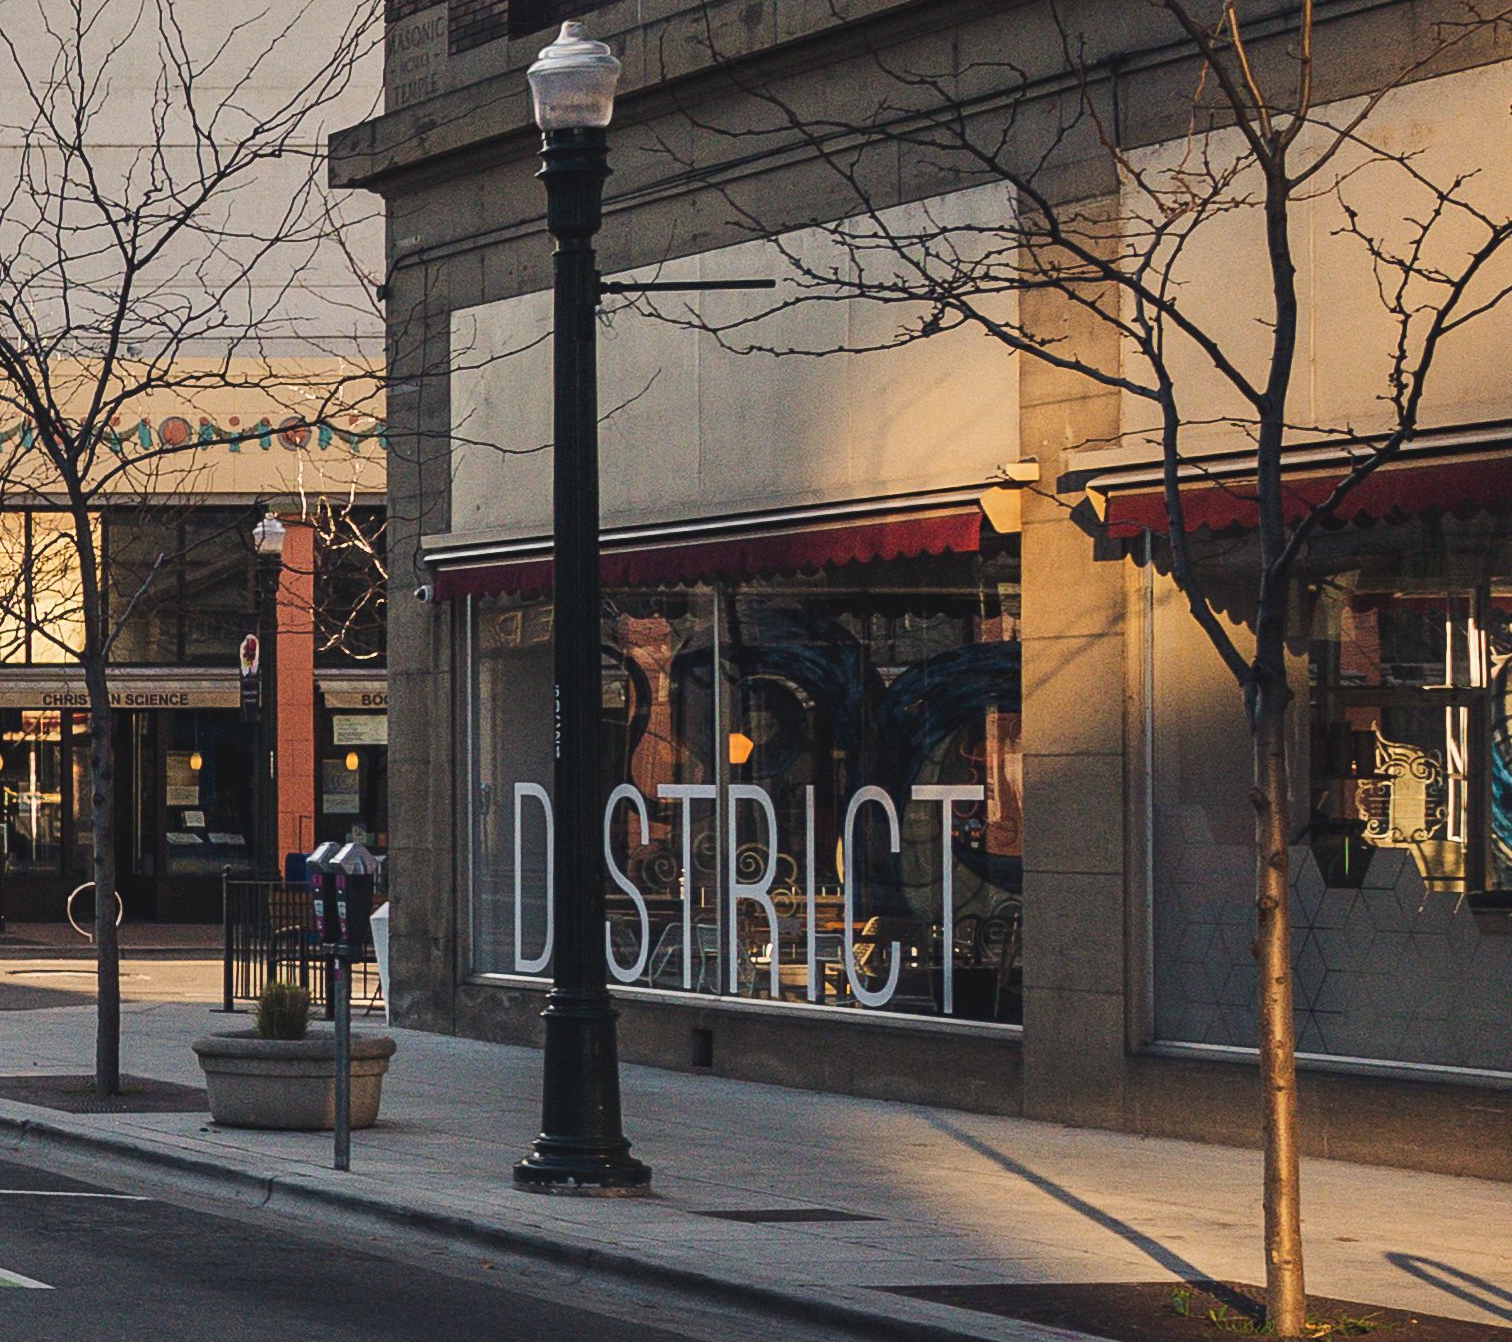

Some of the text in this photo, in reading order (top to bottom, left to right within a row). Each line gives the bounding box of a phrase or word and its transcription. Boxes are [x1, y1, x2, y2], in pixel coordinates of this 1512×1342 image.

[42, 693, 189, 706] CHRISN SCIENCE
[514, 782, 984, 1015] DSTRICT
